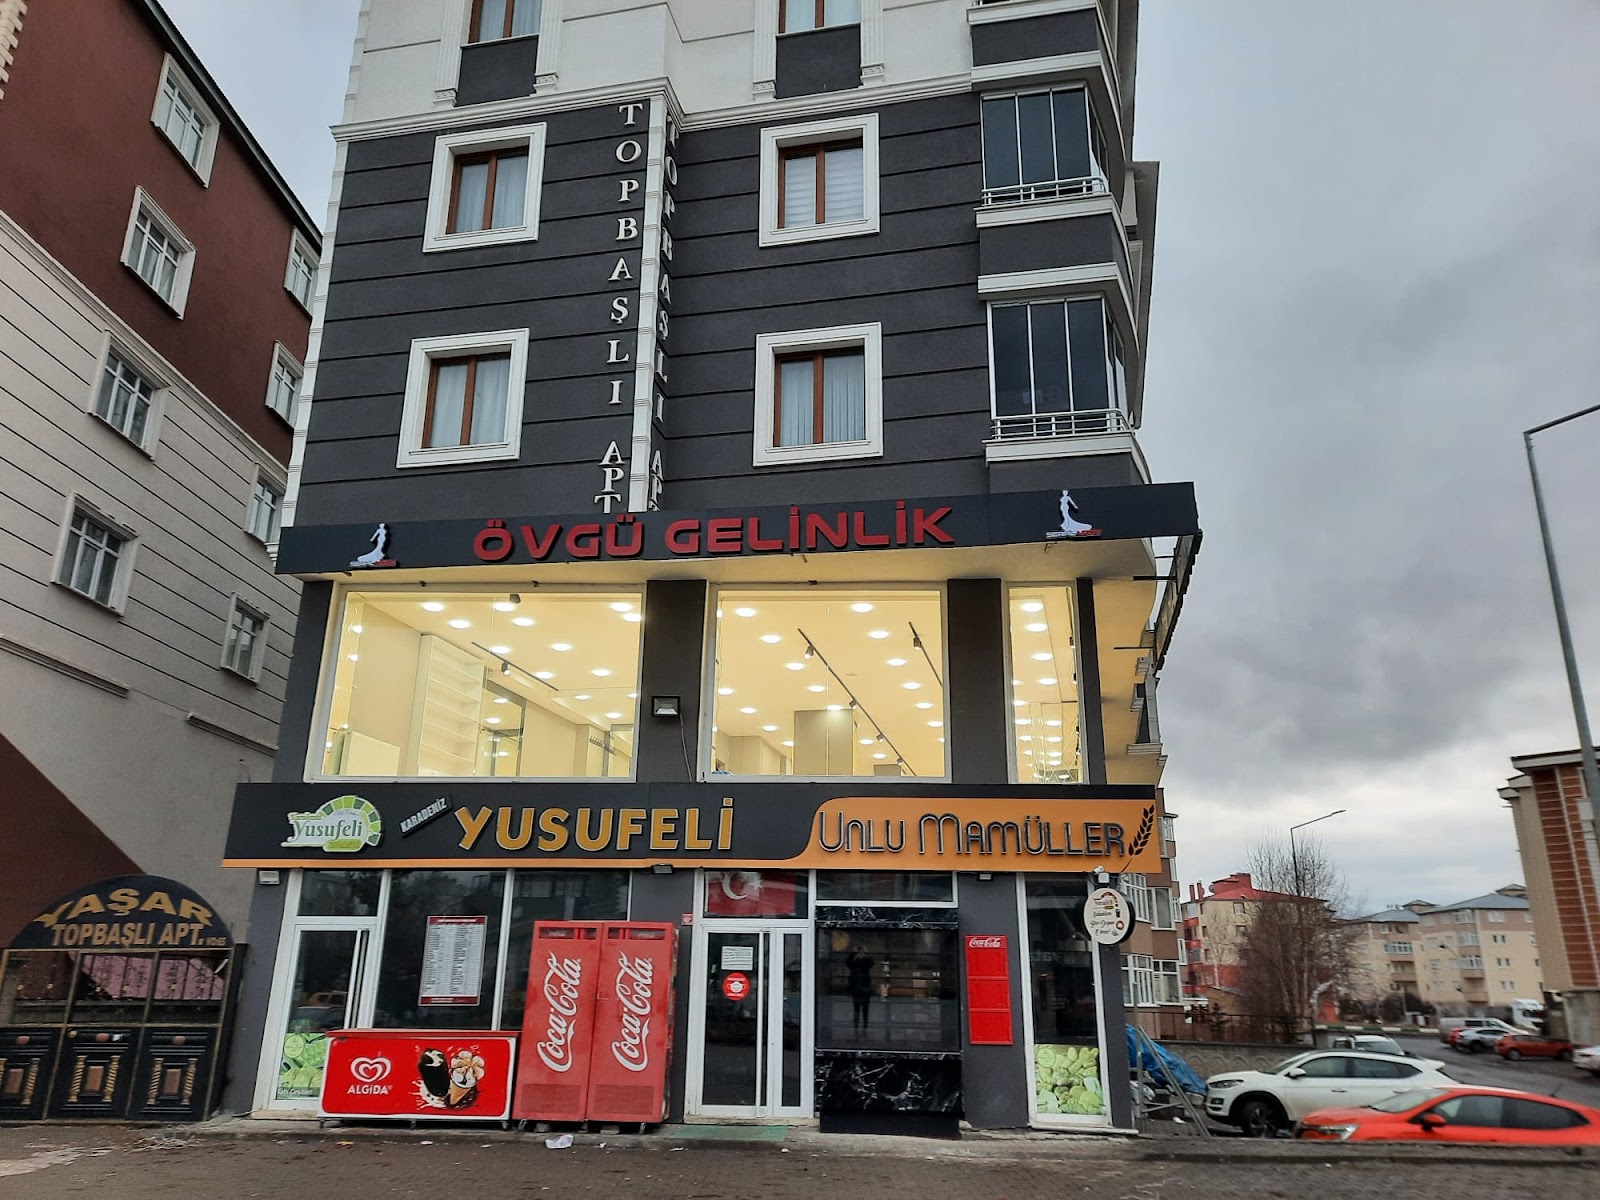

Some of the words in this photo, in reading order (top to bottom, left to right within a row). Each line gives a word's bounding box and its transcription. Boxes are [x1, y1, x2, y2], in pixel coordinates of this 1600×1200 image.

[606, 103, 644, 404] TOPBAŞLI
[473, 514, 643, 561] ÖVGÜ
[664, 500, 955, 553] GELİNLİK
[400, 798, 448, 833] KARADENİZ
[454, 797, 734, 851] YUSUFELİ
[33, 888, 213, 928] YAŞAR
[52, 922, 156, 948] TOPBAŞLI
